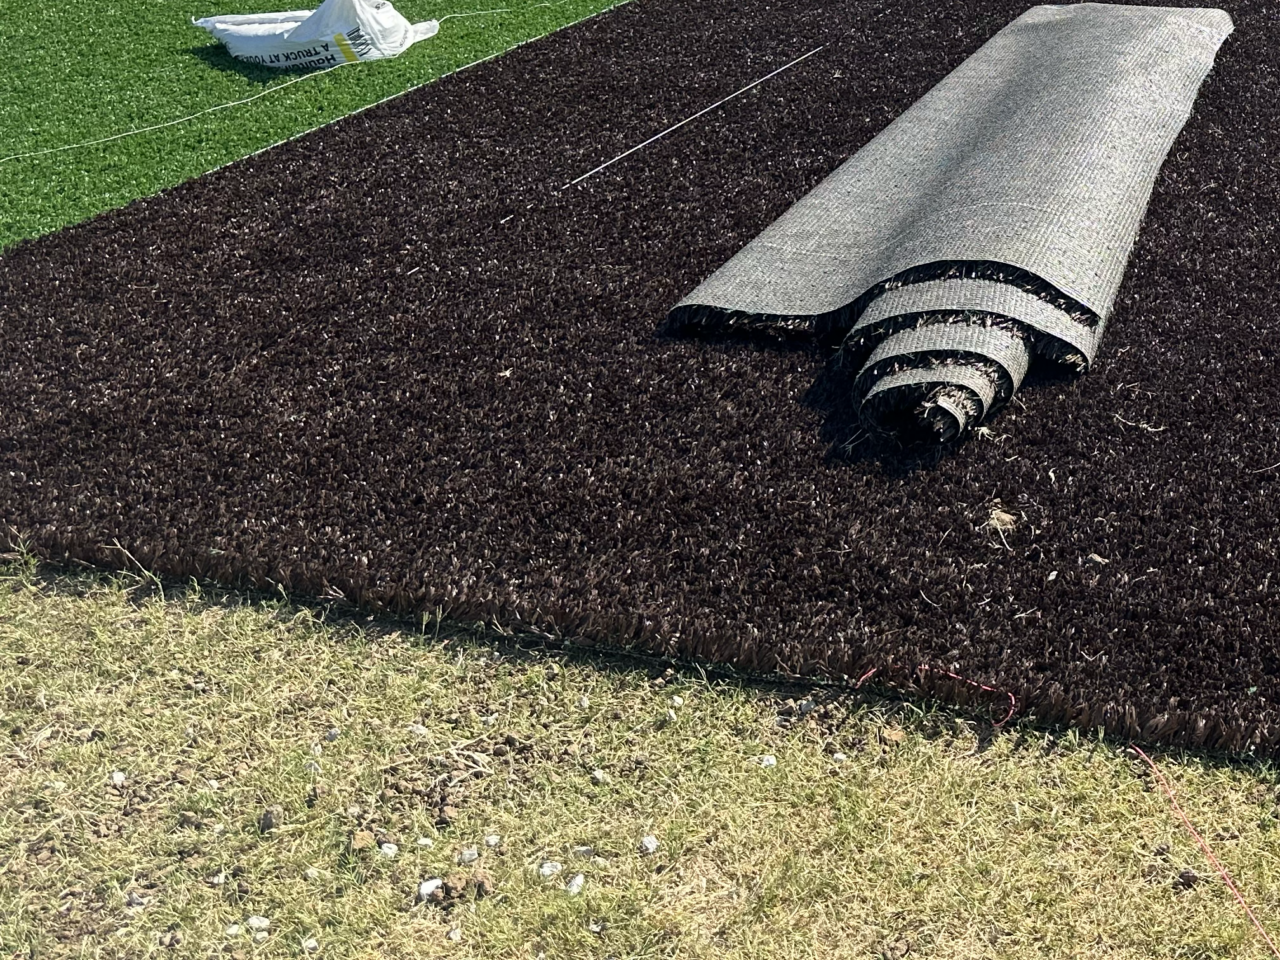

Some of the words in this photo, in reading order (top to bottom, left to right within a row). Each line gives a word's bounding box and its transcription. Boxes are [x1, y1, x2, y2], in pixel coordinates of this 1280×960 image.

[320, 42, 330, 52] A
[269, 53, 281, 63] AT
[282, 46, 321, 61] TRUCK
